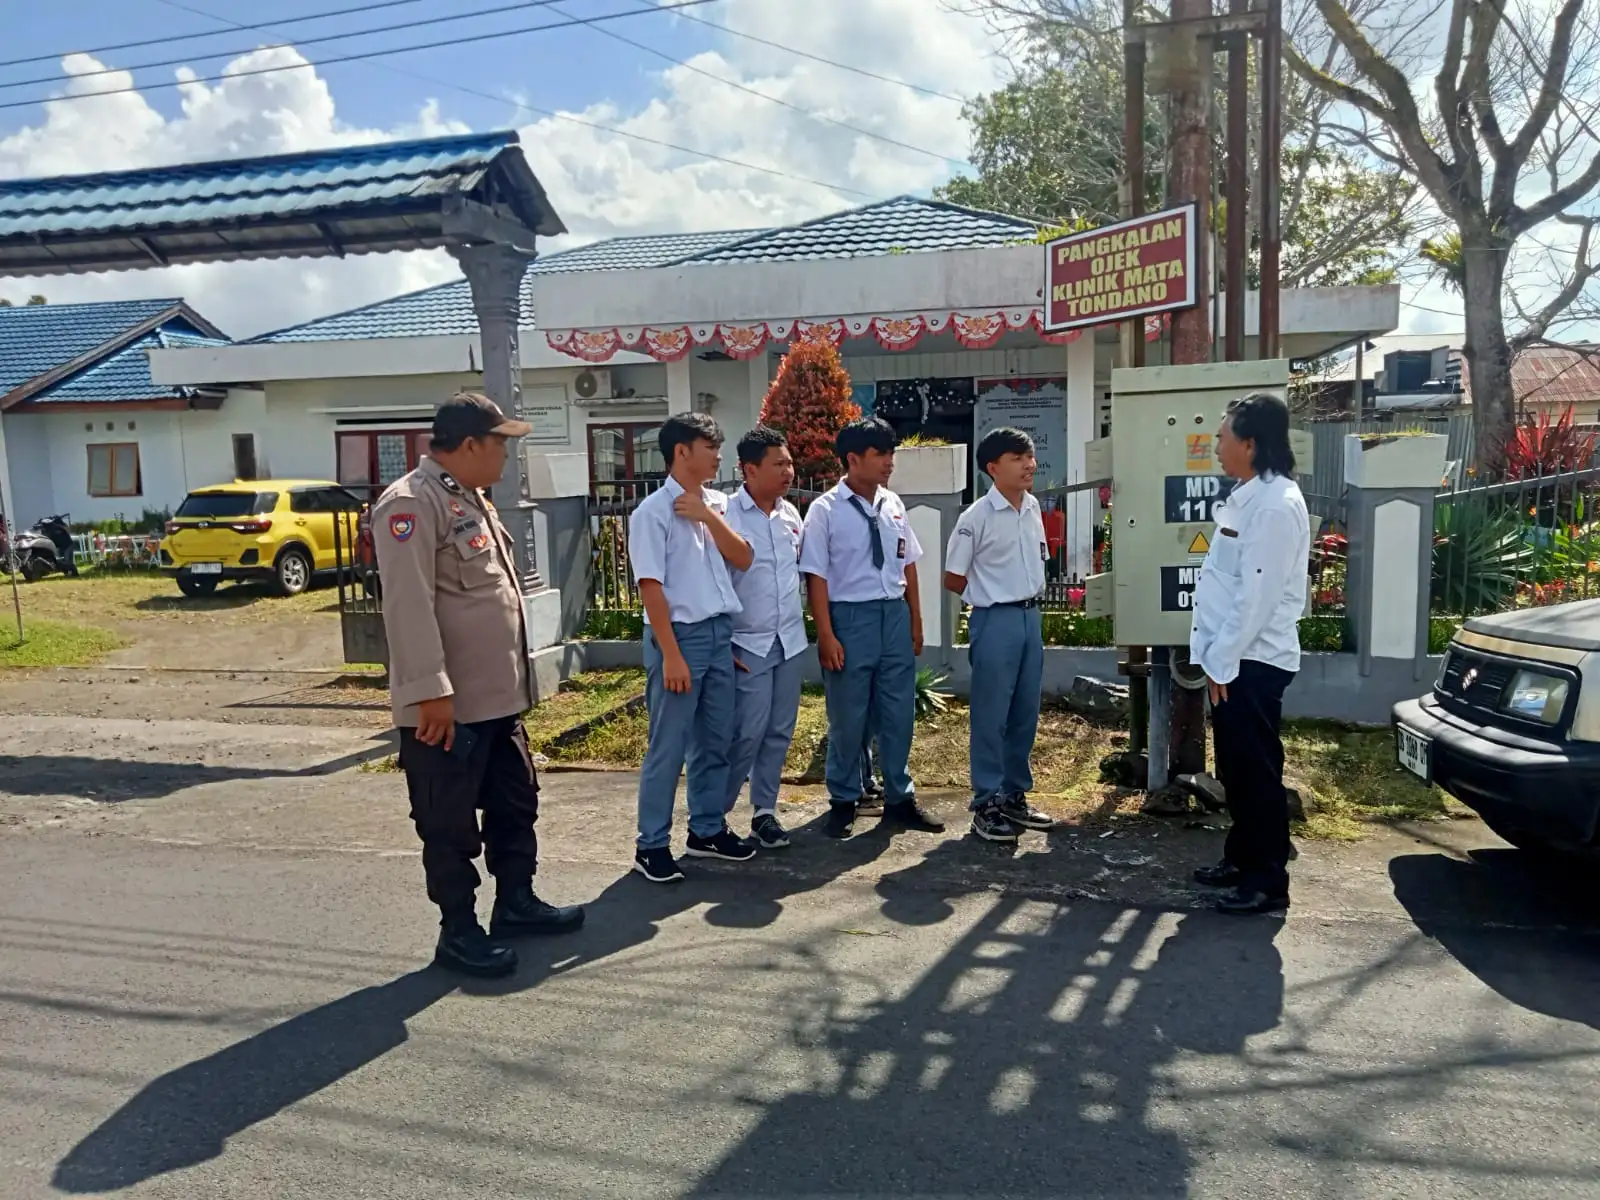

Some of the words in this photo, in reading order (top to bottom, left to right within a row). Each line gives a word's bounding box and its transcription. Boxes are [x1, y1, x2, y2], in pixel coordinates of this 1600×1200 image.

[1058, 218, 1182, 265] PANGKALAN
[1091, 249, 1140, 276] OJEK
[1053, 272, 1119, 302] KLINIK
[1123, 259, 1184, 289] MATA
[1067, 282, 1167, 317] TONDANO
[1185, 476, 1220, 498] MD
